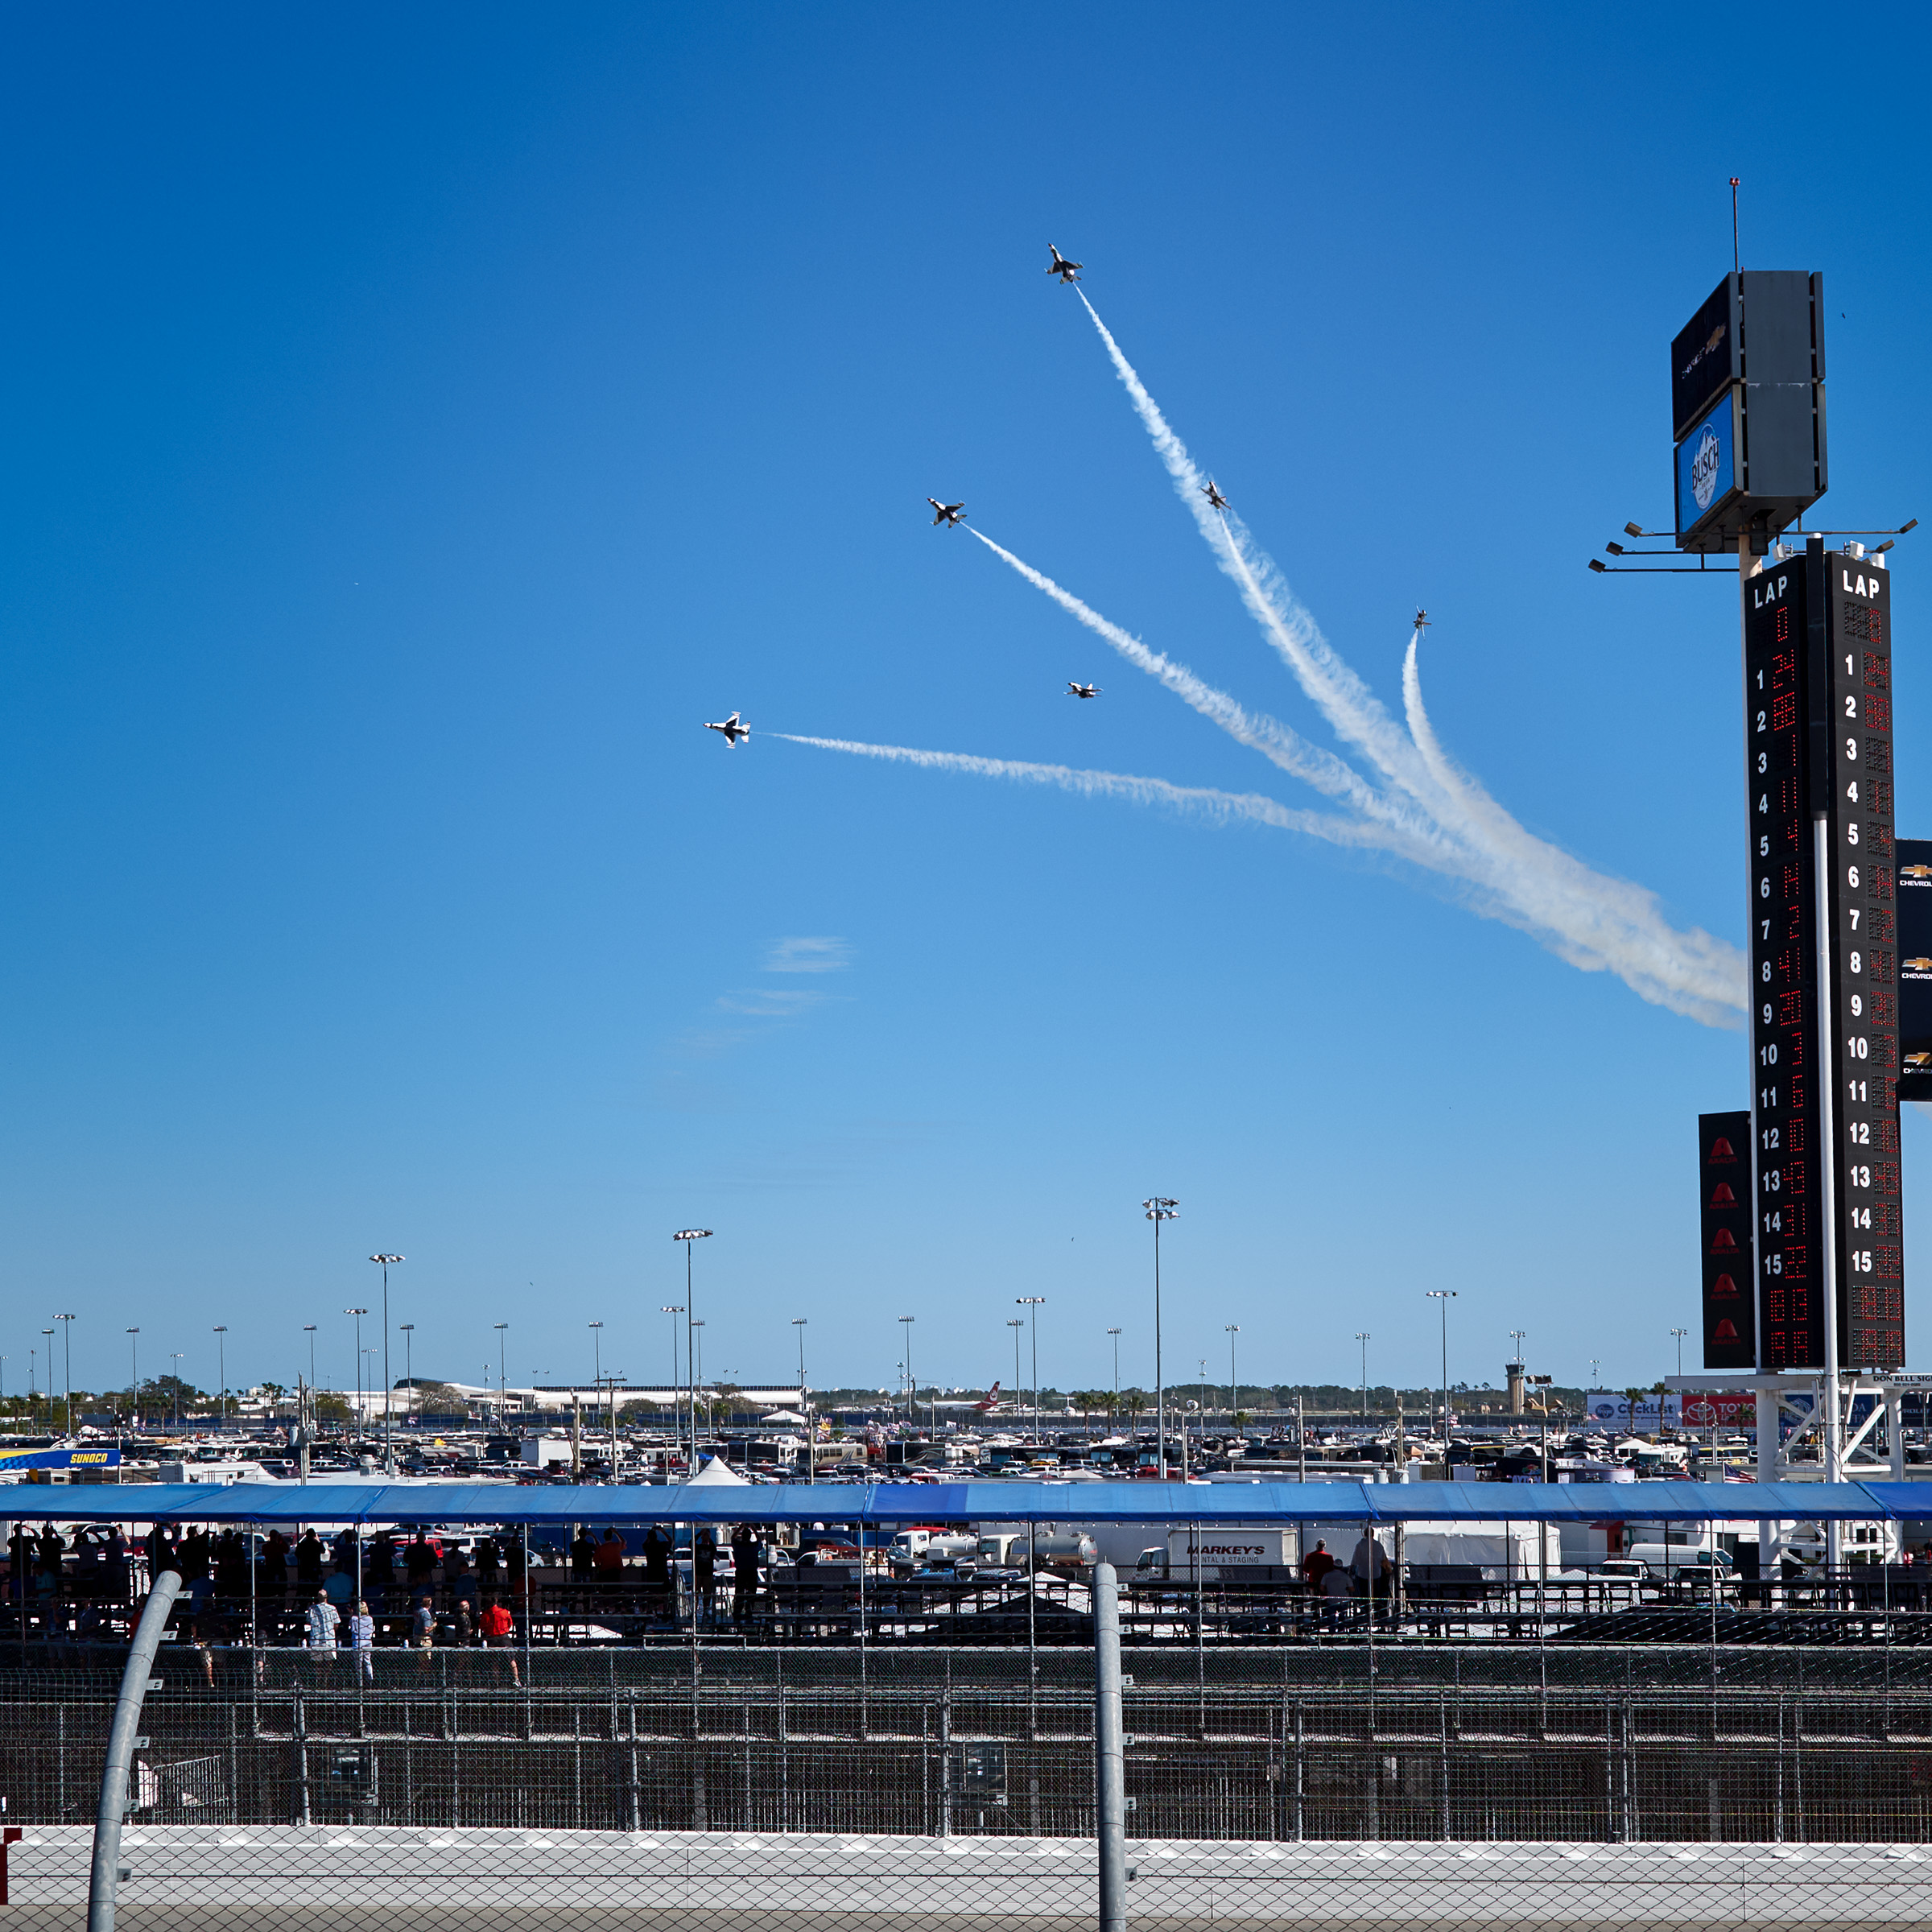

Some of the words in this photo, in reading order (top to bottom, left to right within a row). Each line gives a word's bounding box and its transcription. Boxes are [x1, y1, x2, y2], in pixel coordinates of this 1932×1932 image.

[1691, 439, 1719, 491] BUSCH
[1754, 576, 1787, 609] LAP
[1843, 569, 1880, 599] LAP
[1845, 654, 1853, 675] 1
[1757, 670, 1763, 690] 1
[1845, 696, 1856, 718] 2
[1757, 710, 1766, 733] 2
[1846, 737, 1857, 761] 3
[1757, 752, 1767, 774] 3
[1847, 781, 1859, 803] 4
[1758, 793, 1768, 814] 4
[1847, 823, 1859, 845] 5
[1760, 835, 1769, 857] 5
[1761, 877, 1770, 898] 6
[1847, 865, 1860, 889] 6
[1761, 919, 1770, 940] 7
[1849, 908, 1860, 931] 7
[1762, 960, 1771, 982] 8
[1850, 951, 1861, 974] 8
[1763, 1003, 1773, 1024] 9
[1851, 994, 1863, 1017] 9
[1761, 1043, 1777, 1066] 10
[1847, 1036, 1868, 1059] 10
[1761, 1086, 1777, 1108] 11
[1848, 1080, 1867, 1102] 11
[1762, 1127, 1779, 1150] 12
[1849, 1122, 1870, 1145] 12
[1763, 1170, 1780, 1191] 13
[1850, 1165, 1871, 1188] 13
[1764, 1212, 1781, 1232] 14
[1851, 1207, 1872, 1229] 14
[1765, 1253, 1781, 1275] 15
[1852, 1250, 1872, 1273] 15
[1617, 1403, 1674, 1414] ClckLst
[70, 1453, 108, 1463] SUNOCO
[1187, 1546, 1265, 1555] MARKEY'S
